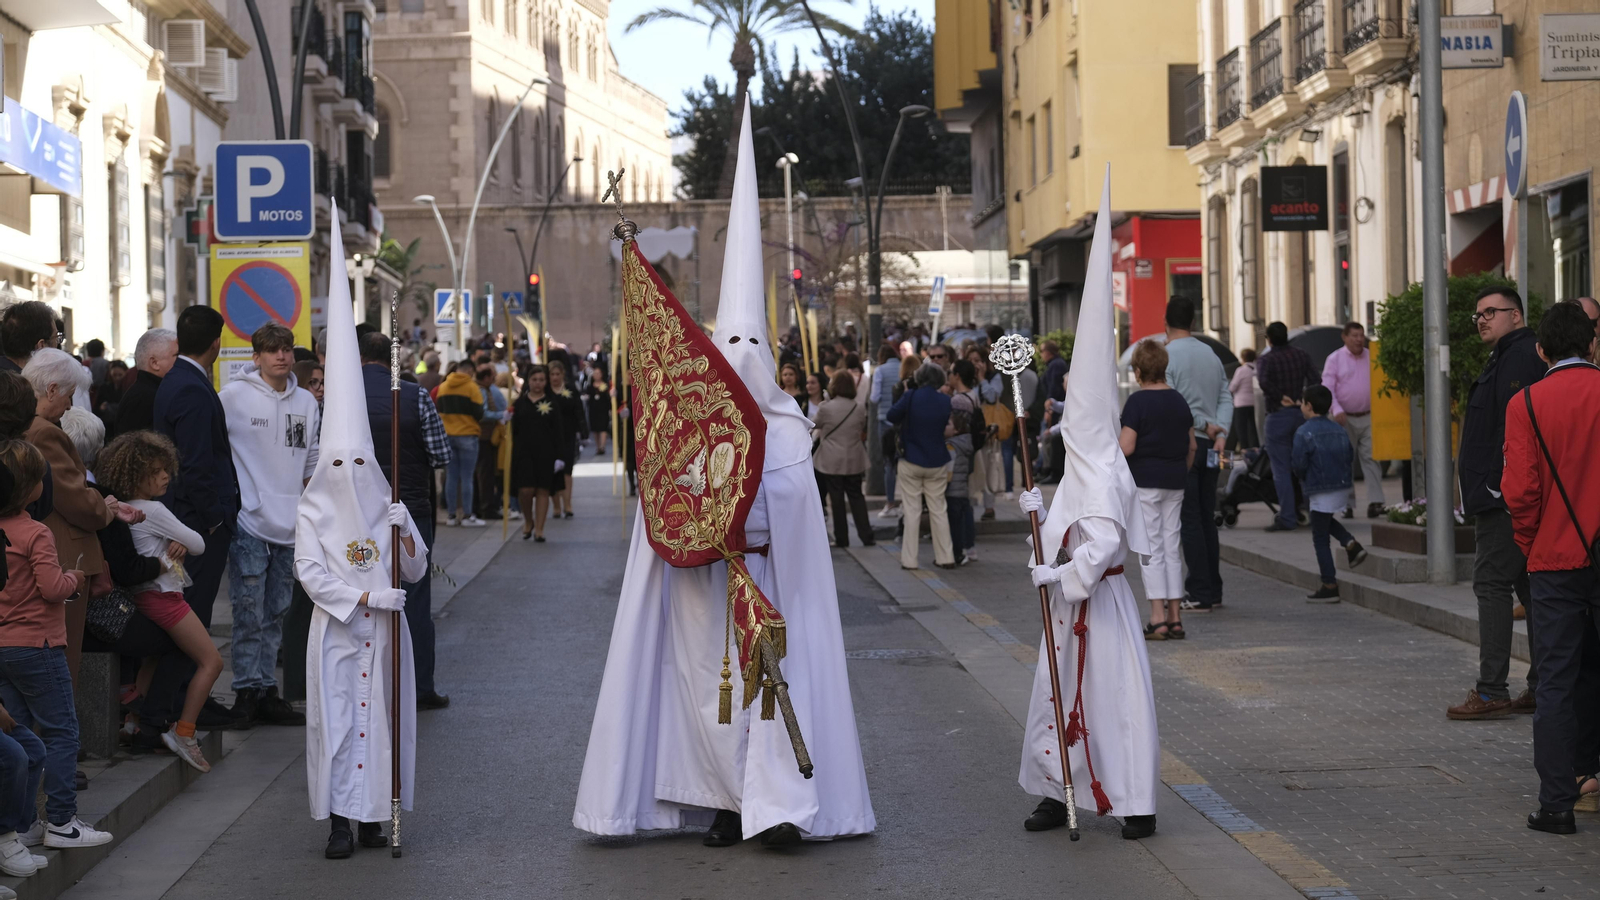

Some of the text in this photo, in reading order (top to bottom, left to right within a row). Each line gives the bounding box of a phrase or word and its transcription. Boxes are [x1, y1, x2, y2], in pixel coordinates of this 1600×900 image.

[1441, 19, 1459, 29] DEMIA
[1460, 19, 1467, 29] DE
[1441, 35, 1493, 51] NABLA
[1547, 45, 1600, 62] Tripia
[1552, 65, 1591, 73] JARDINERIA
[236, 154, 286, 223] P
[1270, 200, 1319, 215] acanto
[259, 209, 303, 222] MOTOS
